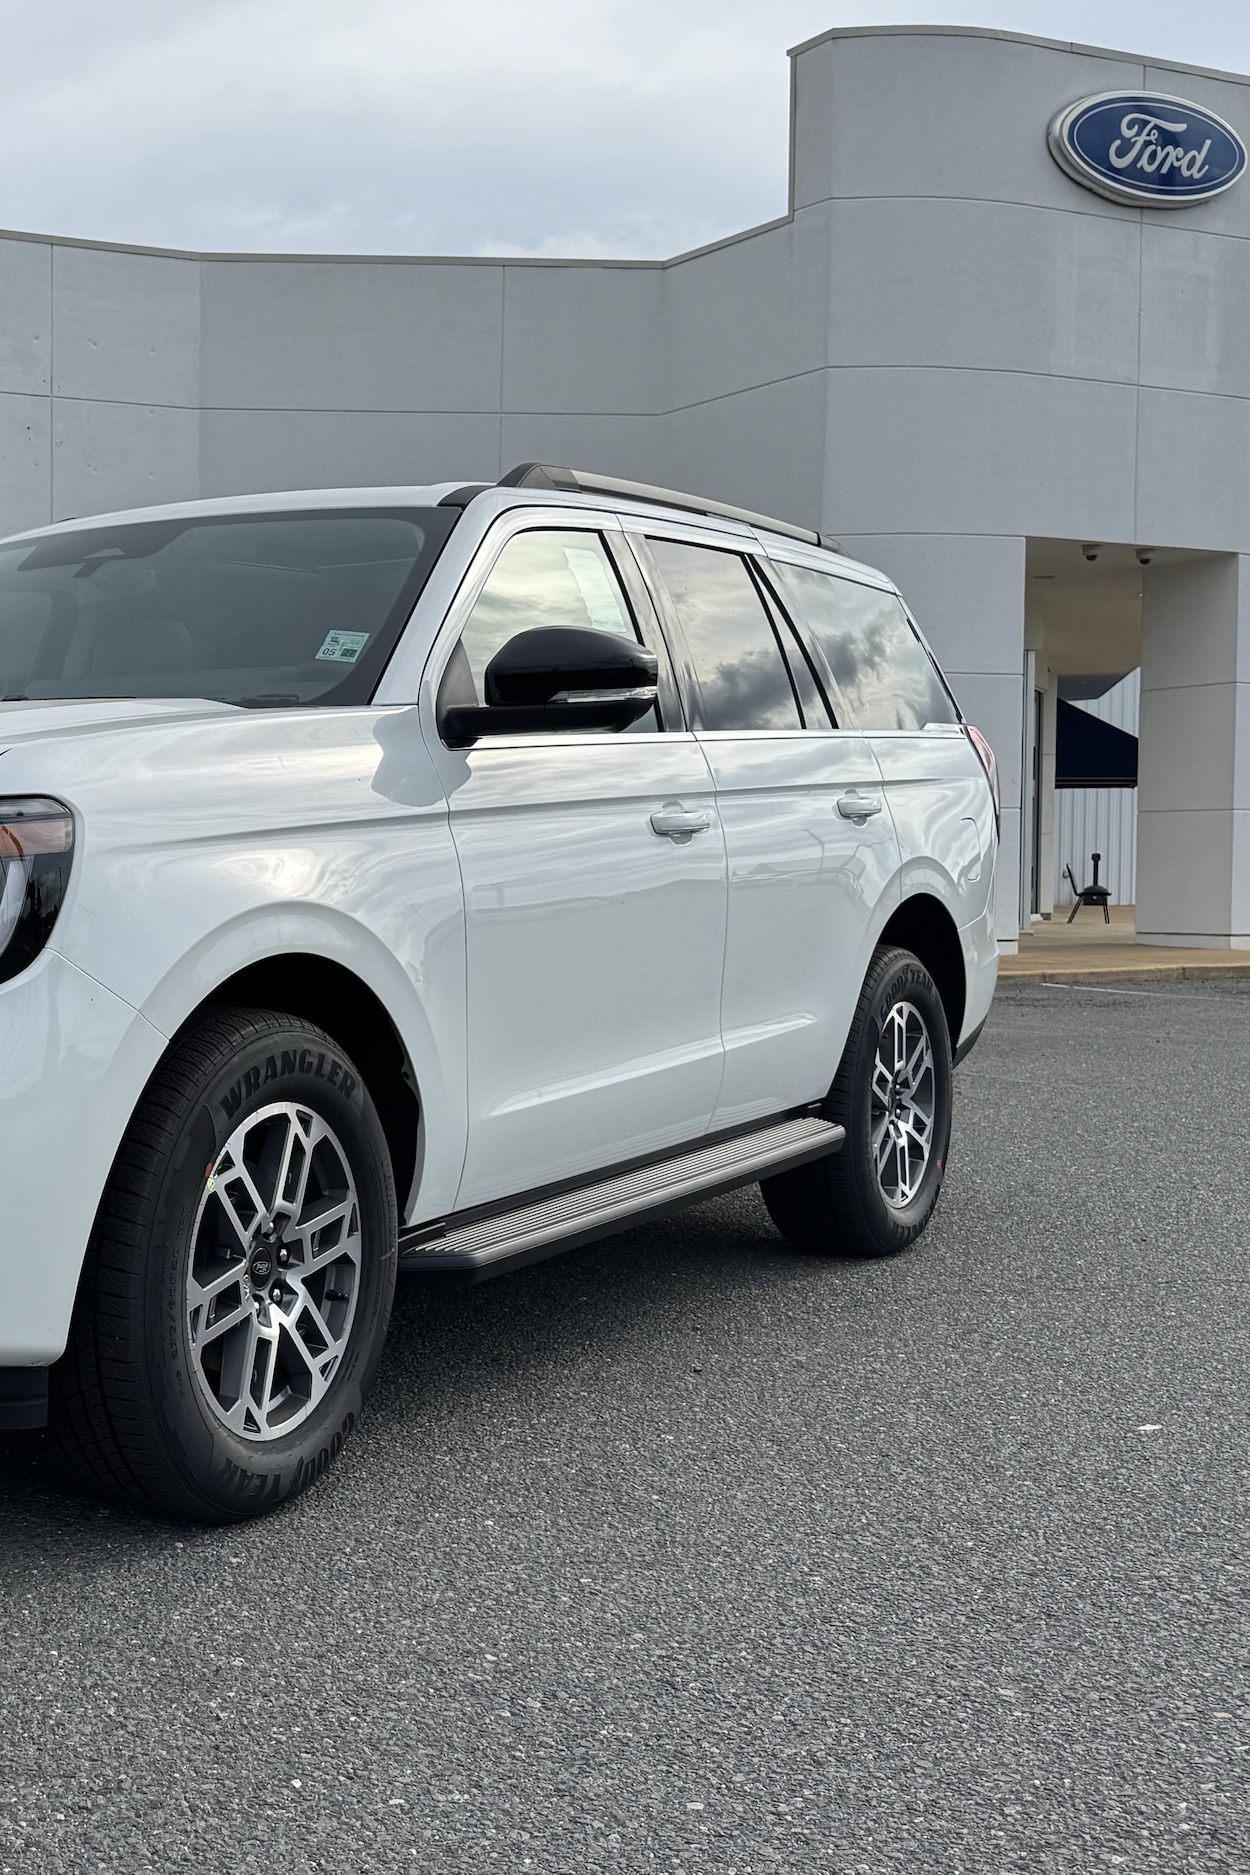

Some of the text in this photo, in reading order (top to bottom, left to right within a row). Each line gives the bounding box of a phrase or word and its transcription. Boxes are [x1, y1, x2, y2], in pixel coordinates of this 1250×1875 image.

[1108, 112, 1212, 180] Ford
[322, 648, 336, 656] 05
[219, 1049, 356, 1120] WRANGLER
